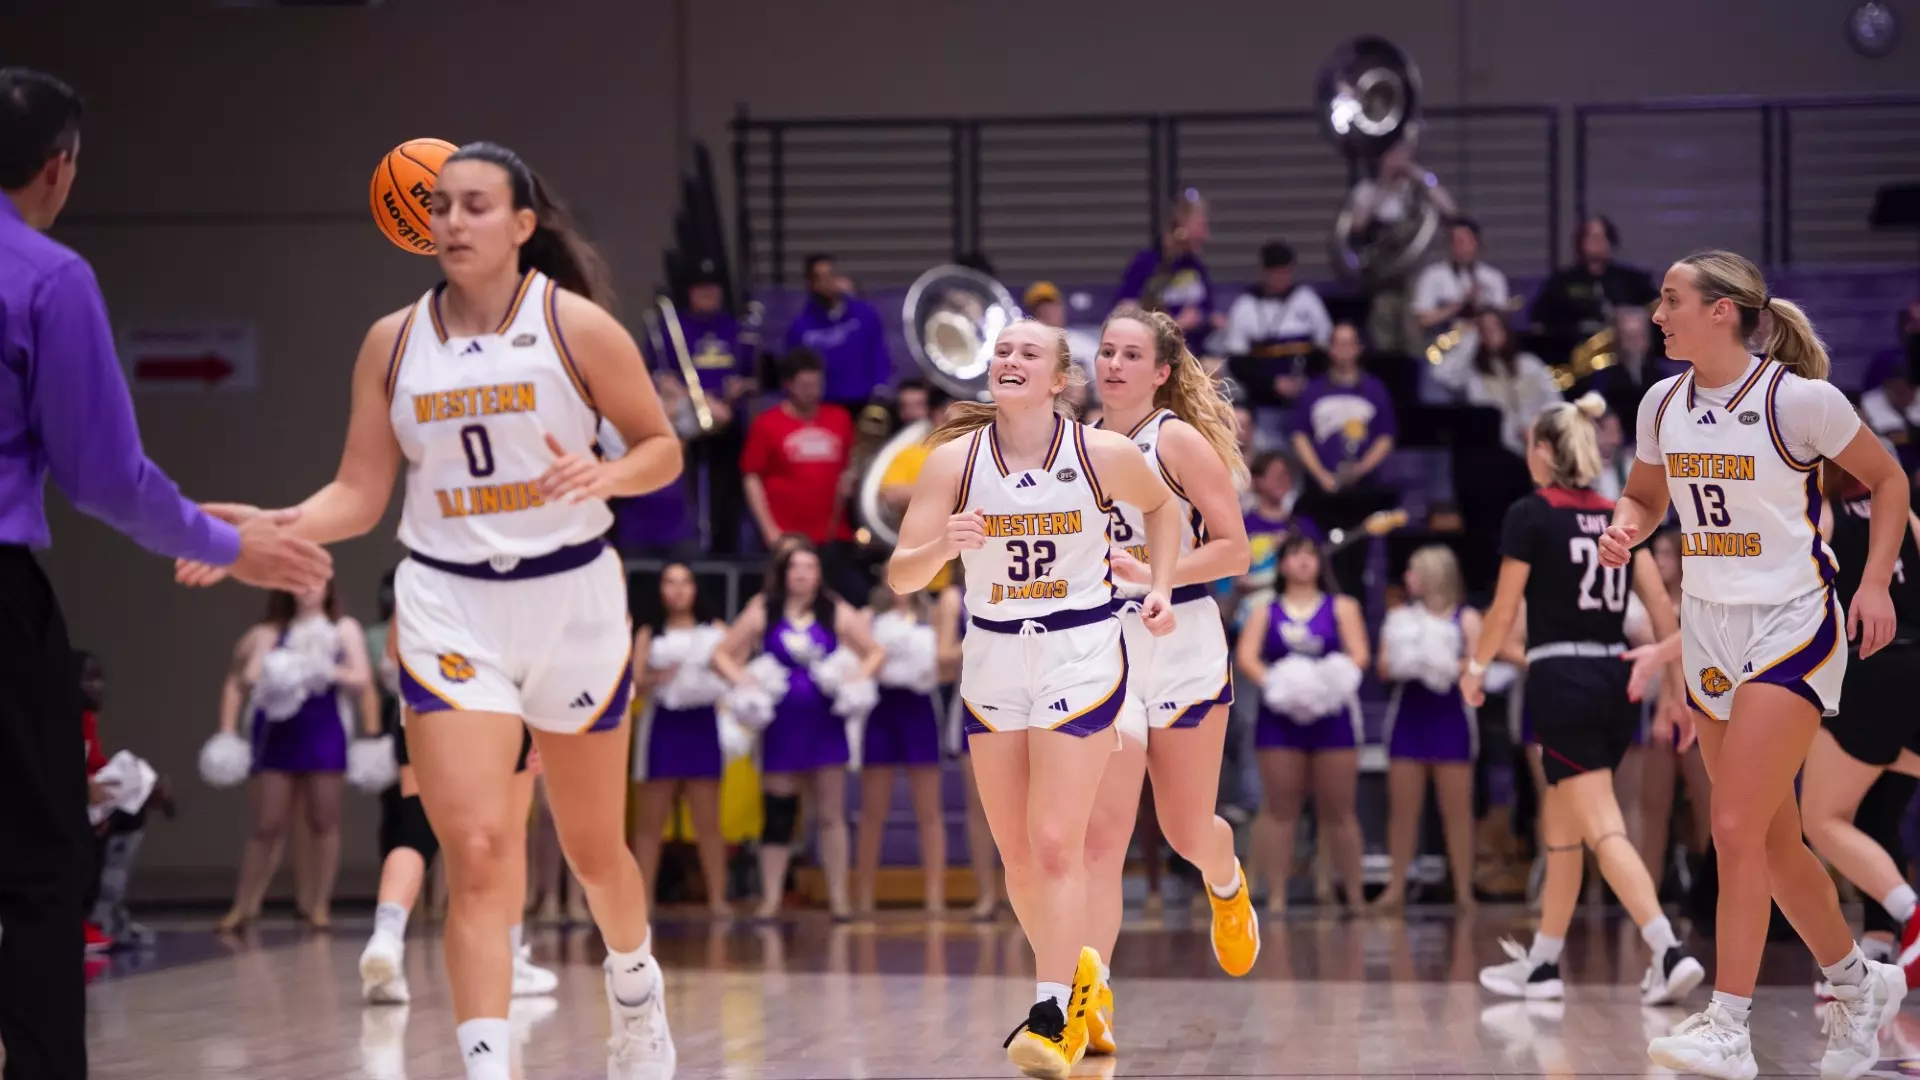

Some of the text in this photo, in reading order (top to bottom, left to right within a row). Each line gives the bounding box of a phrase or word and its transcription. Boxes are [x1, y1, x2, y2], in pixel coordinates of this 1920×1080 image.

[383, 190, 436, 252] Wilson
[412, 382, 536, 424] WESTERN
[461, 423, 495, 478] 0
[1665, 453, 1755, 480] WESTERN
[983, 510, 1083, 537] WESTERN
[1688, 483, 1731, 527] 13
[1006, 540, 1057, 582] 32
[1681, 532, 1762, 557] LLINOIS
